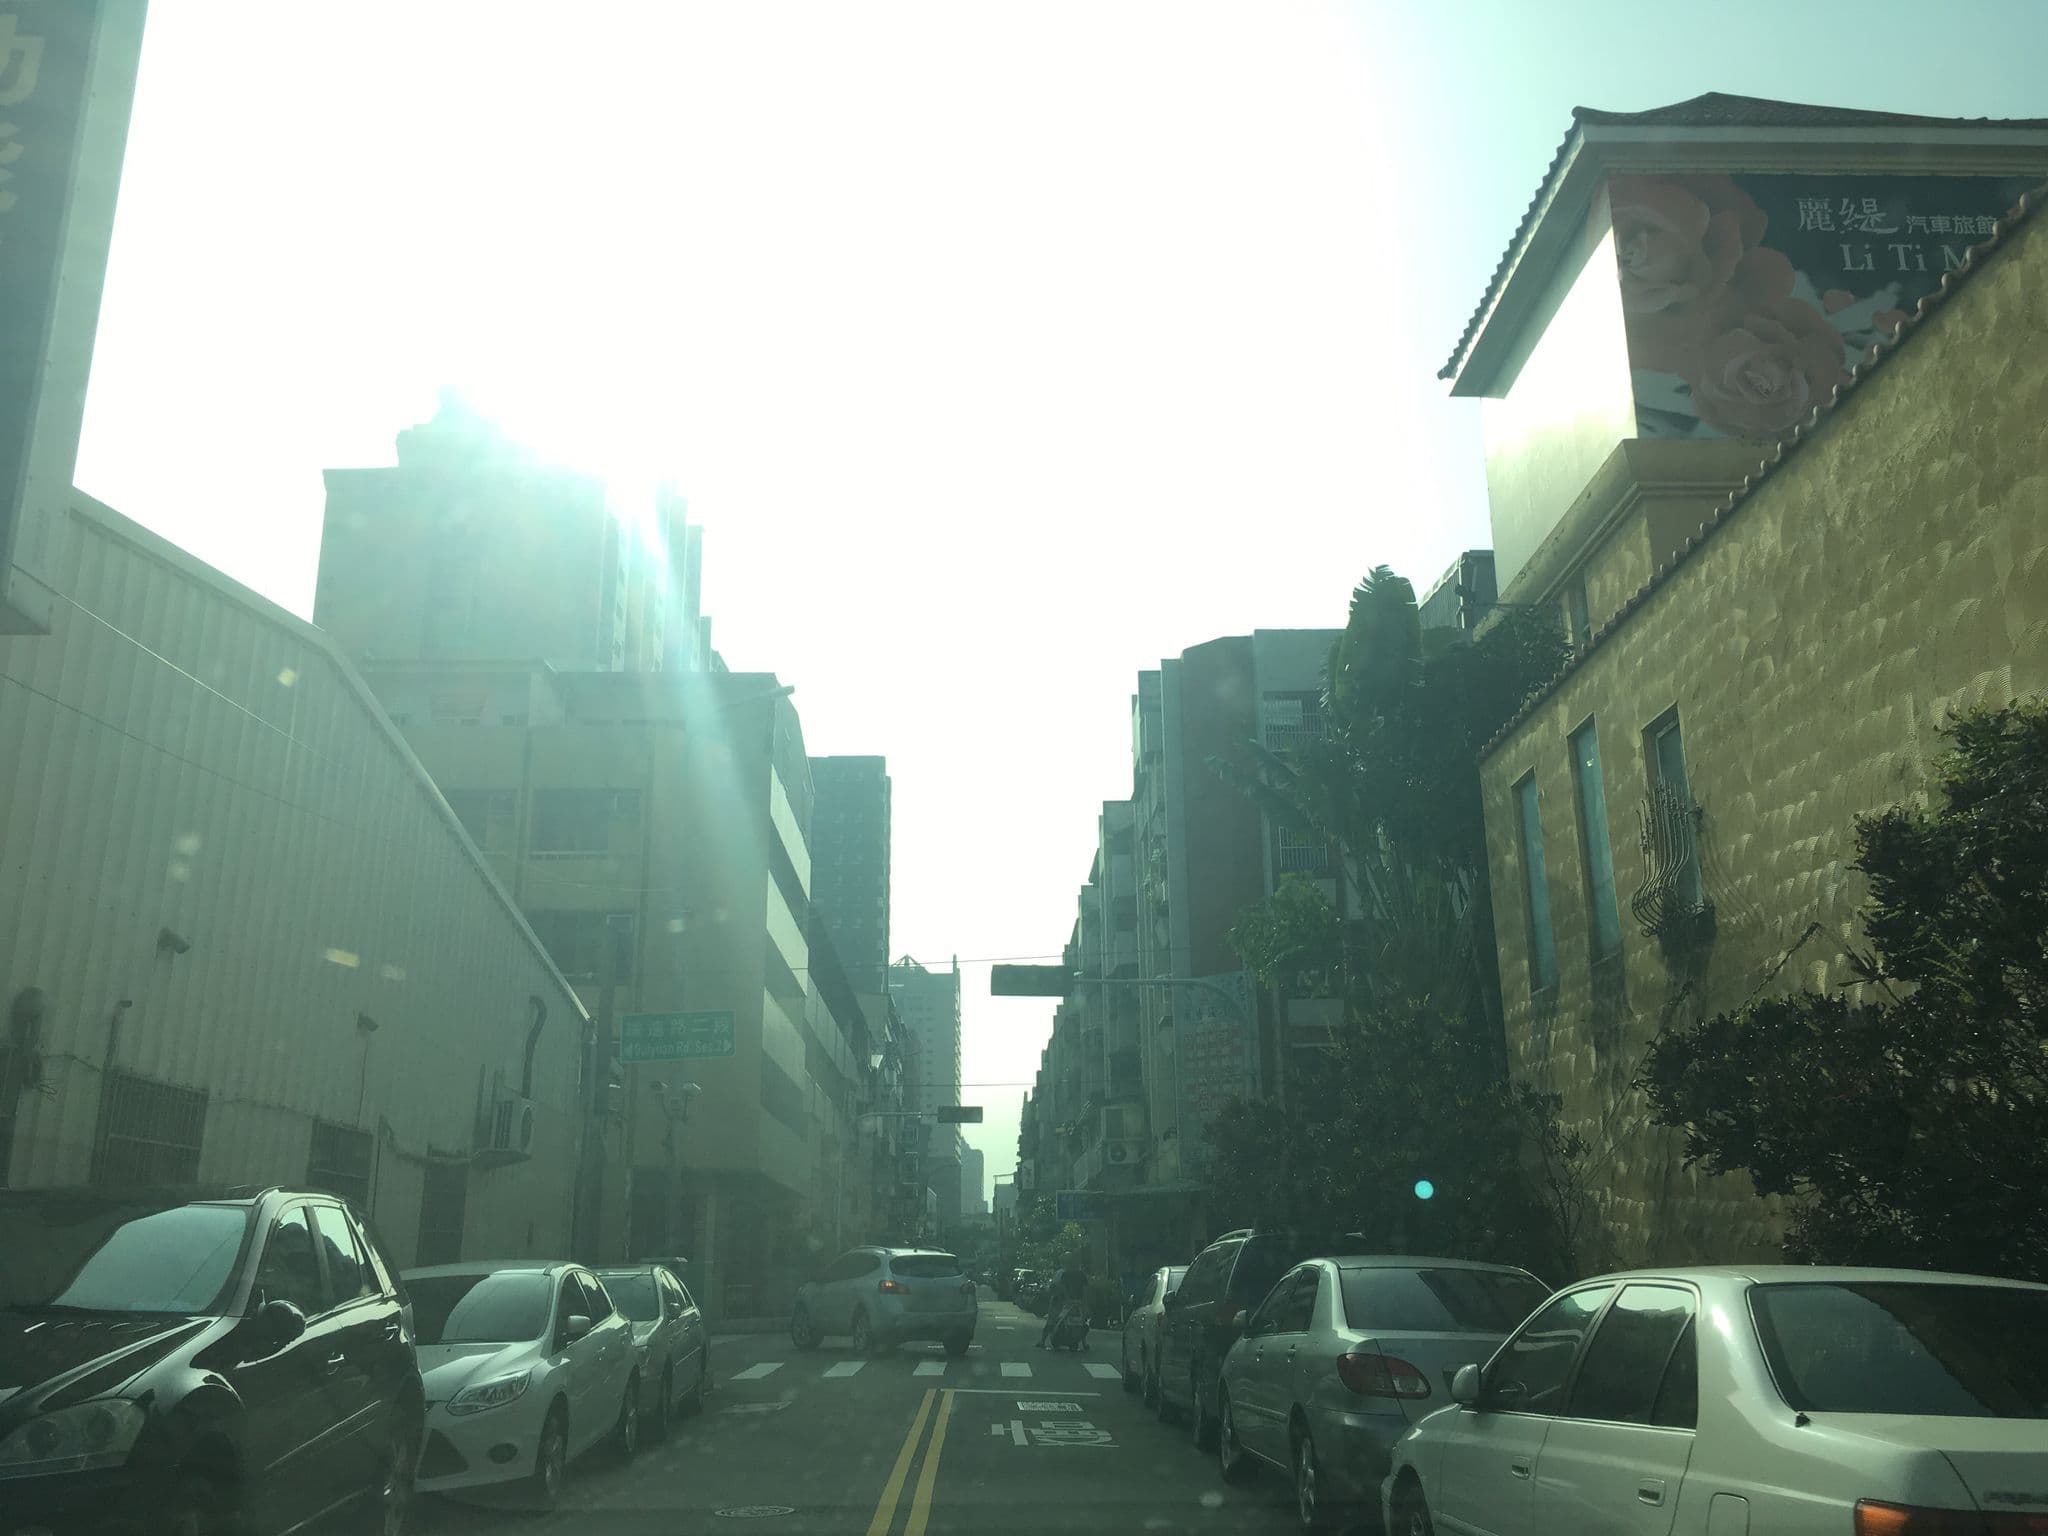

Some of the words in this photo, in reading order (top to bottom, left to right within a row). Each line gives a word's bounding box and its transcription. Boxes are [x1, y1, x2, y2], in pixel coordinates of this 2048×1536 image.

[1906, 215, 1999, 234] 汽車旅館
[1840, 244, 1875, 271] Li
[1888, 244, 1927, 271] Ti
